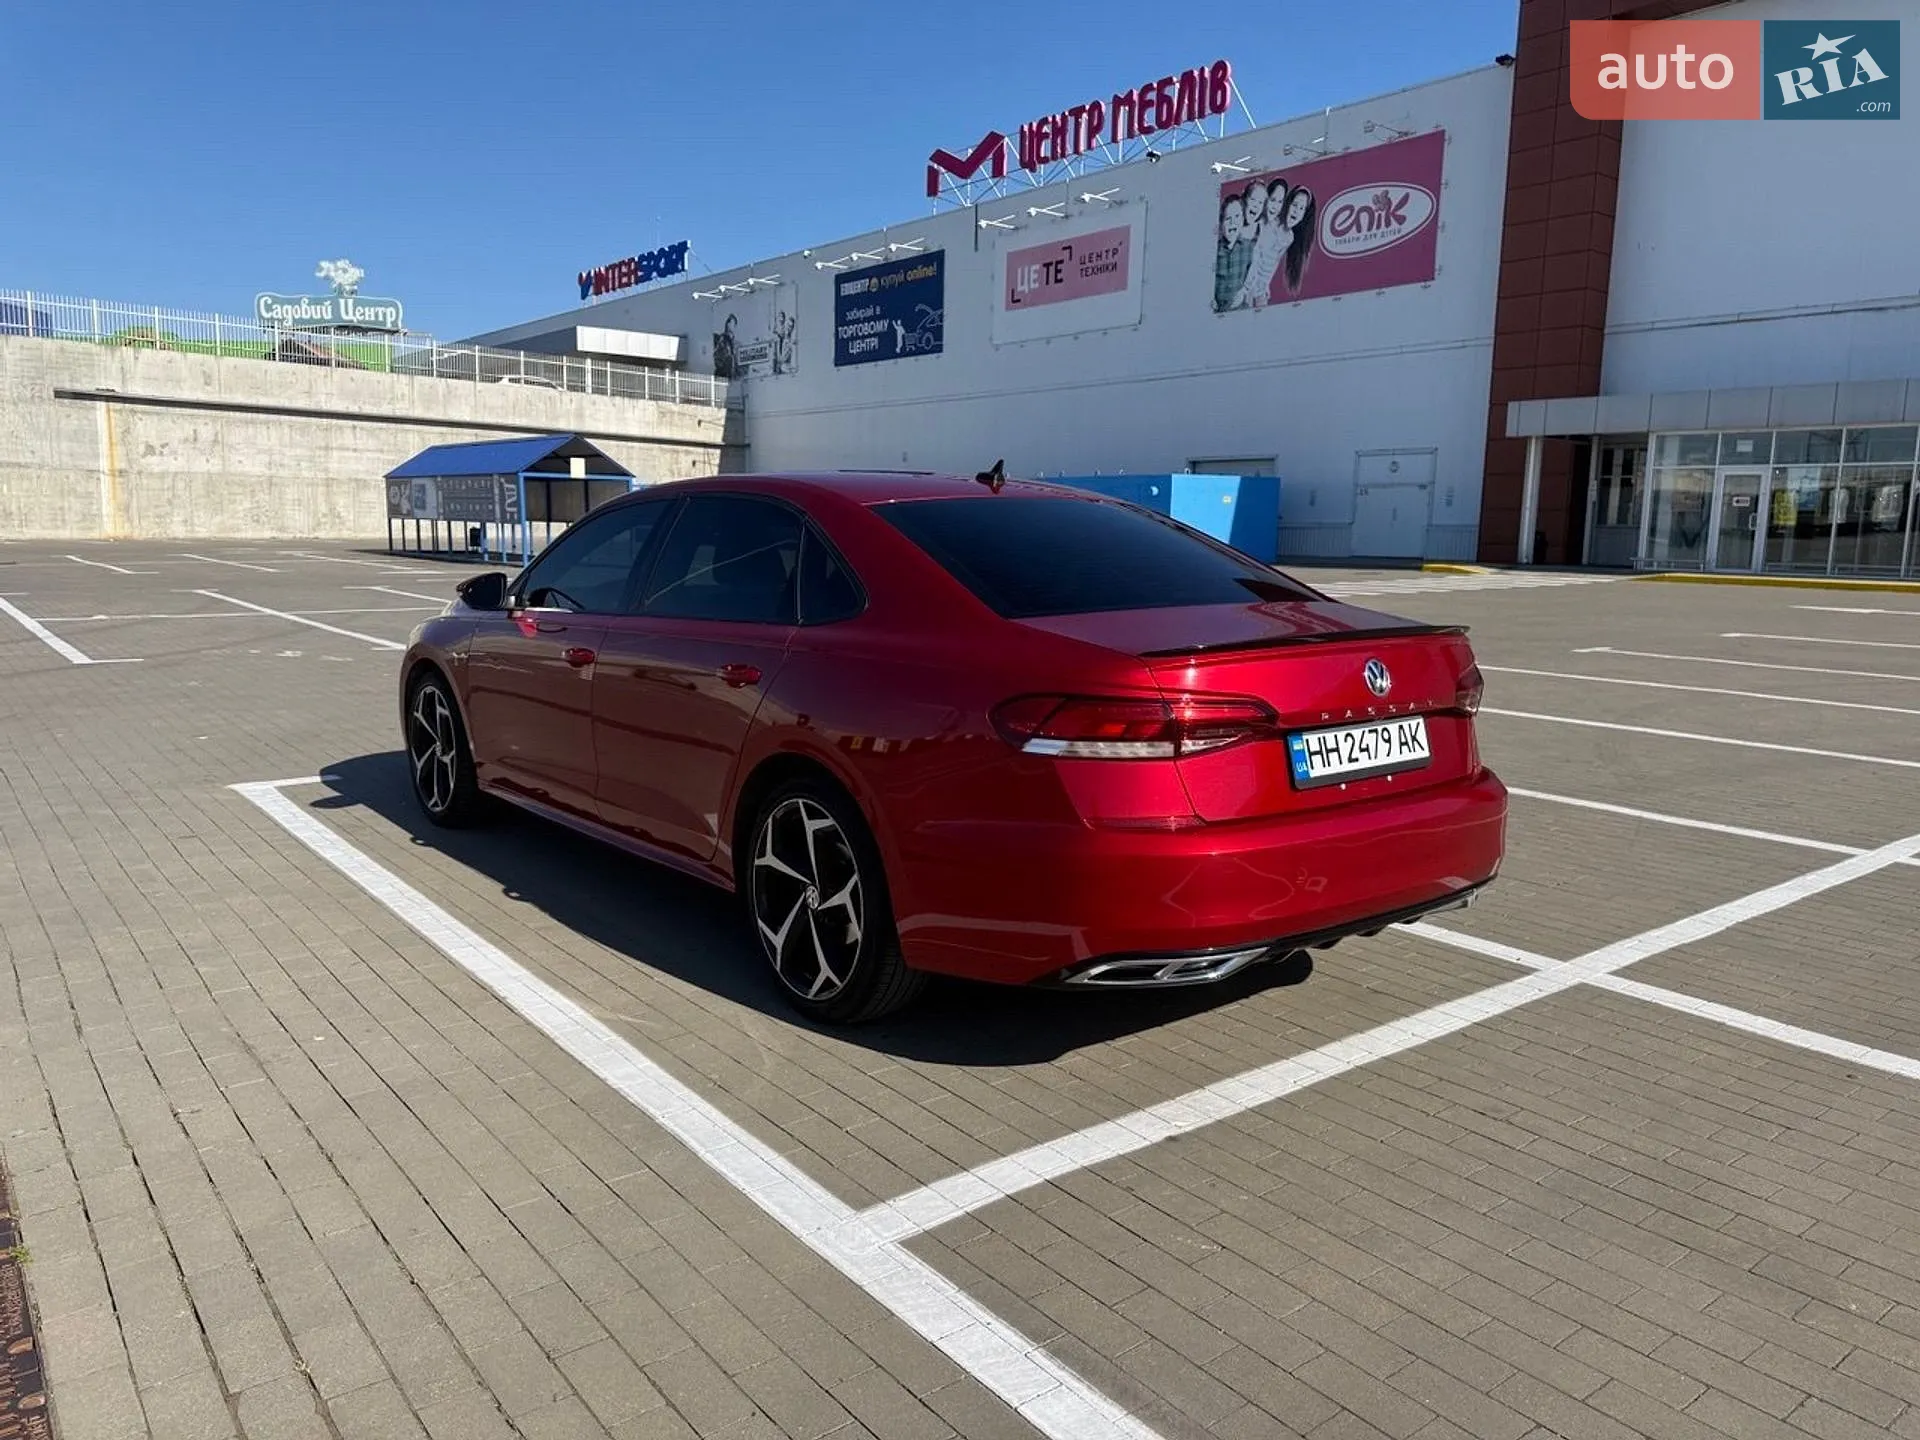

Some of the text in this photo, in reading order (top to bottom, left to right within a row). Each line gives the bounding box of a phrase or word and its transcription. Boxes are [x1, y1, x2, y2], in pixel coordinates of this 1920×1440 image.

[1019, 100, 1106, 173] ЦЕНТР
[1111, 60, 1231, 144] МЕБЛІВ
[592, 240, 691, 296] INTERSPORT
[1080, 247, 1119, 266] ЦЕНТР
[1079, 262, 1118, 279] ТЕХНІКИ
[259, 296, 396, 328] Садовий Центр
[838, 319, 889, 340] ТОРГОВОМУ
[848, 336, 879, 355] ЦЕНТРІ
[1305, 720, 1425, 771] HH 2479 AK
